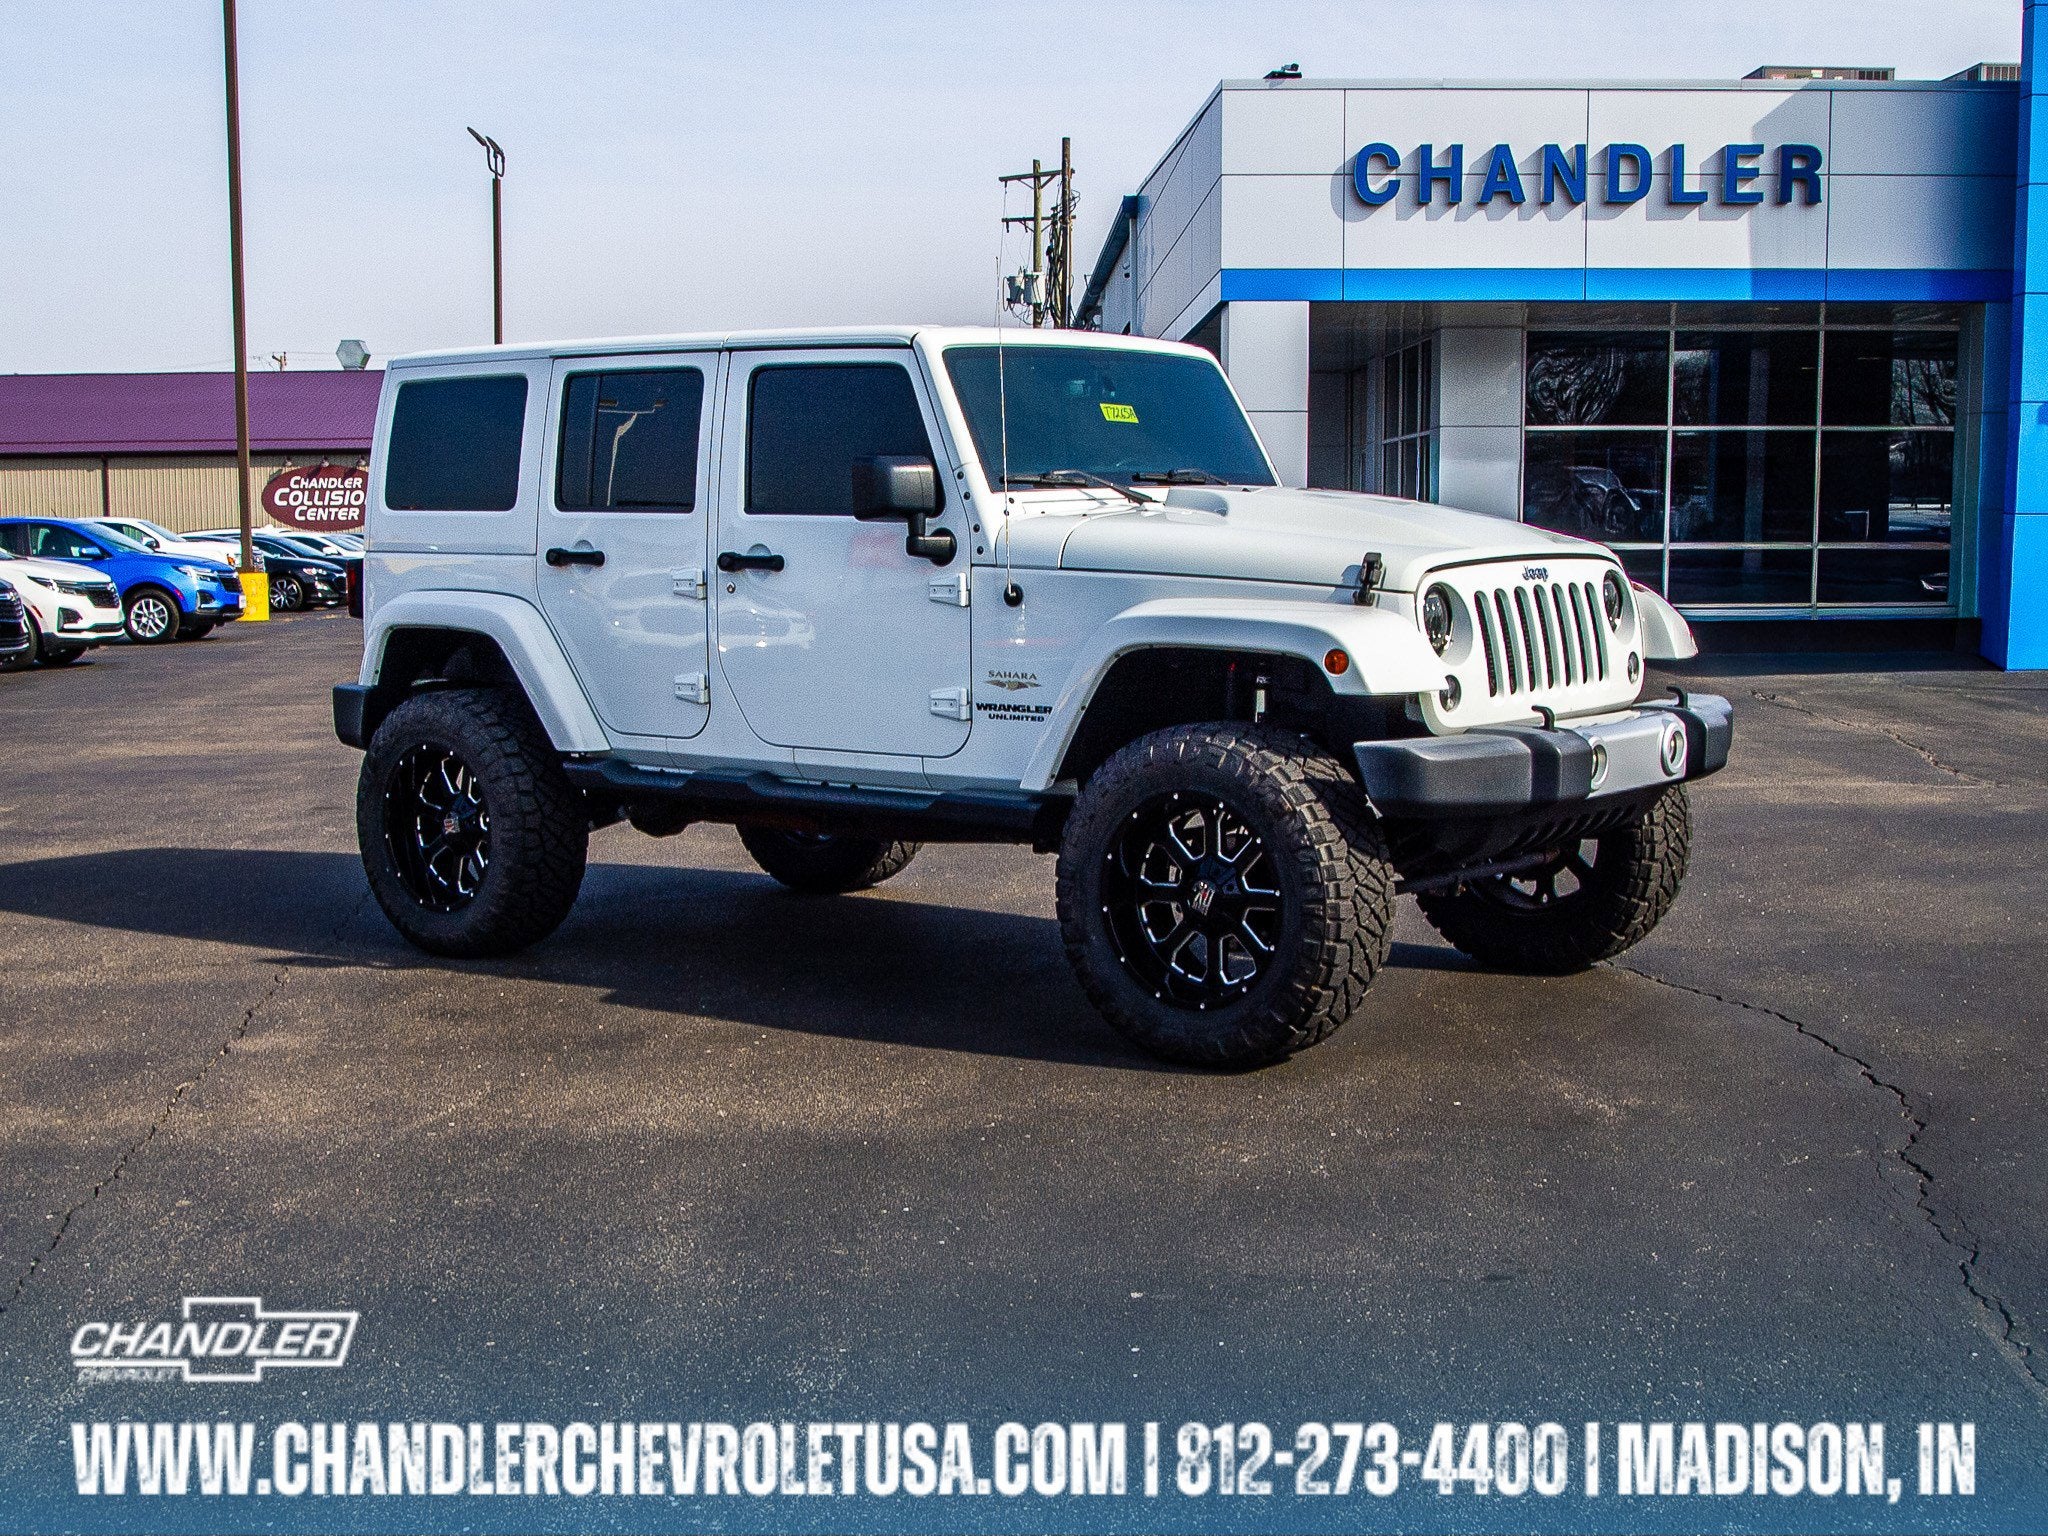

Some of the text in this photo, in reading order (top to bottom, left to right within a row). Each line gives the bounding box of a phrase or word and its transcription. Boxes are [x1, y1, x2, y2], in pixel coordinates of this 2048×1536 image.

[1353, 142, 1823, 205] CHANDLER
[289, 476, 362, 488] CHANDLER
[274, 488, 366, 506] COLLISIO
[294, 506, 360, 520] CENTER
[1522, 565, 1549, 582] Jeep
[988, 670, 1037, 680] SAHARA
[976, 703, 1053, 715] WRANGLER
[988, 713, 1045, 723] UNLIMITED
